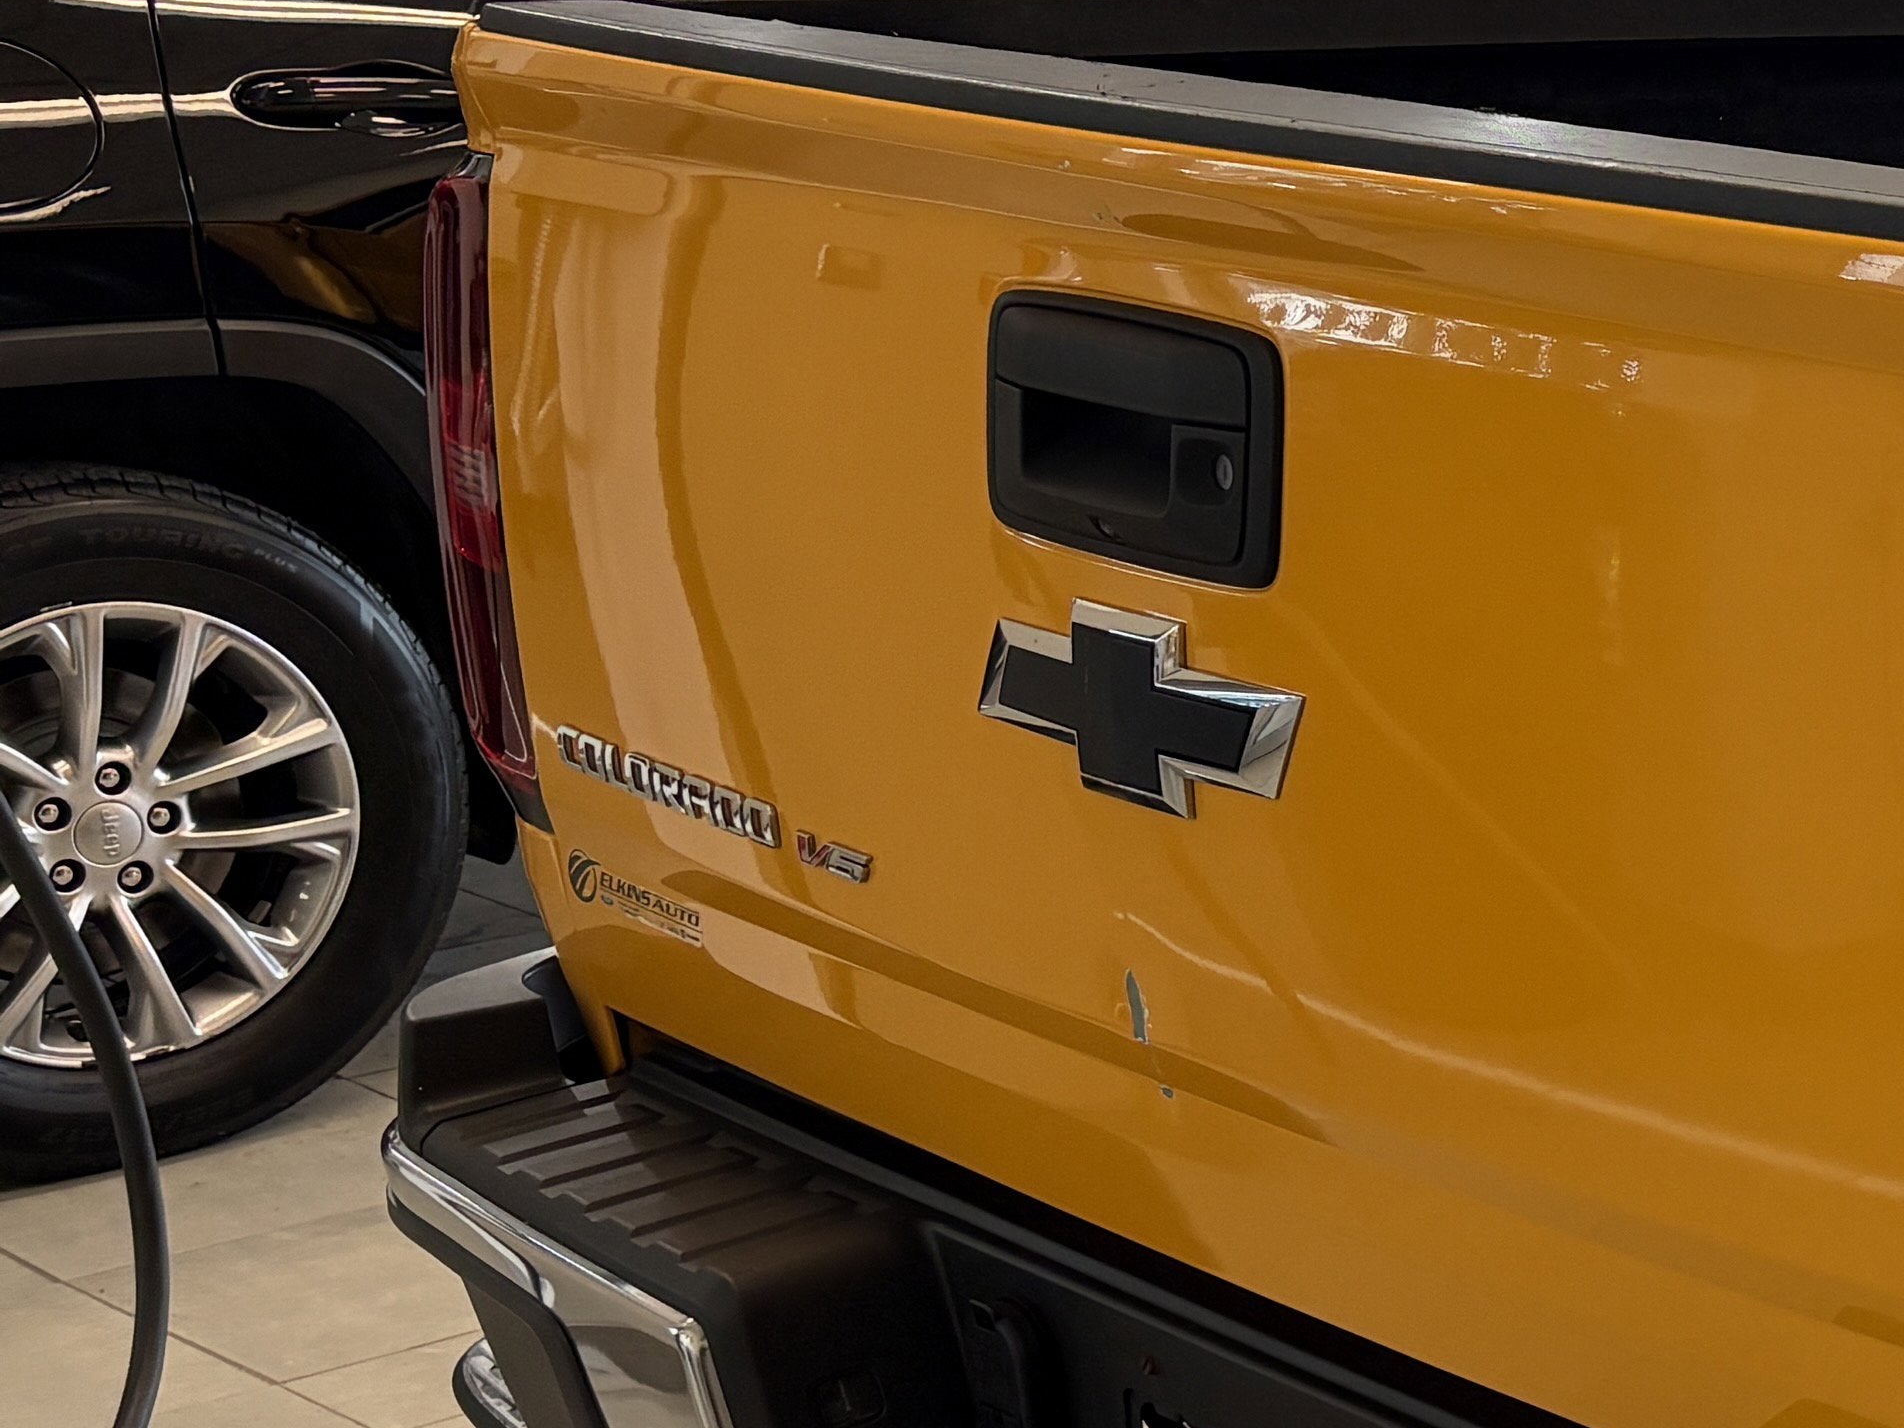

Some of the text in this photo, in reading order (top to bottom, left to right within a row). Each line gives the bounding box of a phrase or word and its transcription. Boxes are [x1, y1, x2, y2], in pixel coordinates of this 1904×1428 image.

[556, 723, 873, 884] COLORADO V6
[600, 871, 652, 907] ELKINS
[652, 898, 700, 927] AUTO
